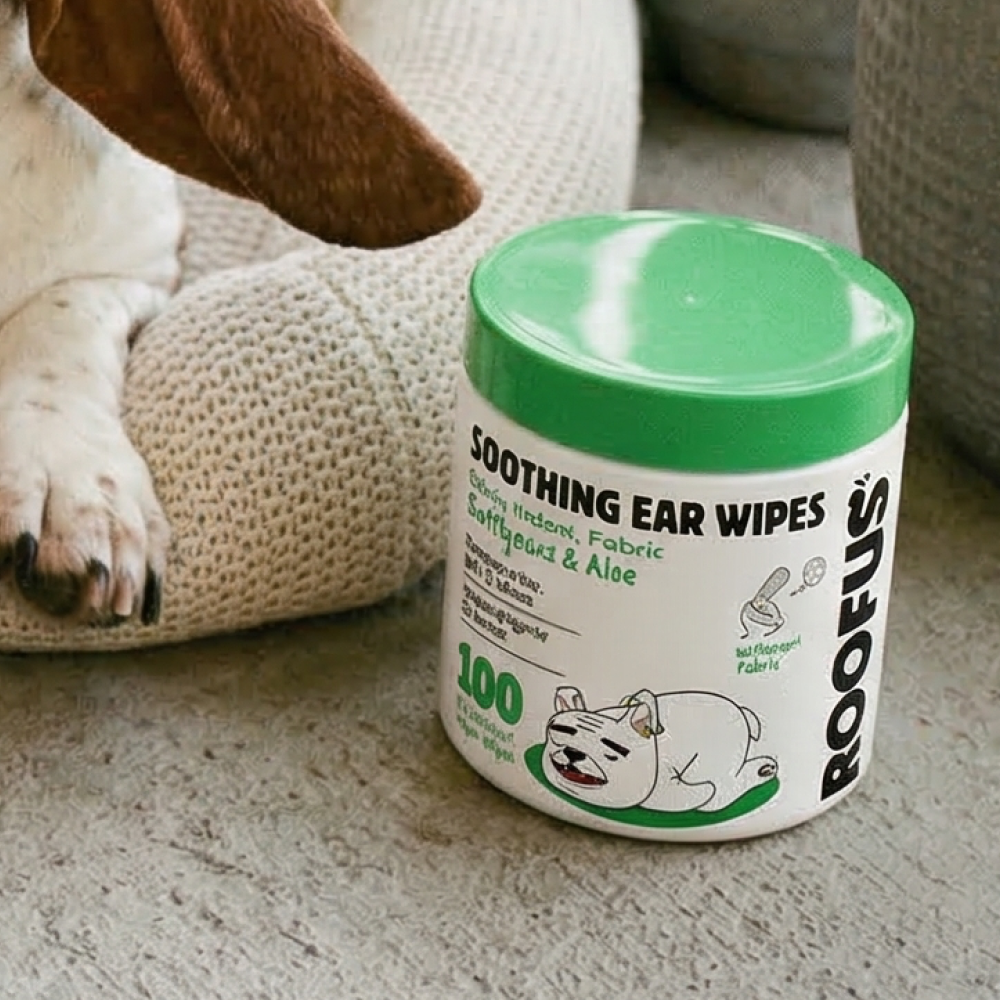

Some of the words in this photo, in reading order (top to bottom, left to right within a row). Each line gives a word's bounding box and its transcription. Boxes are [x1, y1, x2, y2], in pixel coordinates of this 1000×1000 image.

[470, 424, 620, 525] SOOTHING
[631, 495, 705, 536] EAR
[715, 491, 826, 537] WIPES
[562, 547, 579, 573] &
[585, 553, 638, 587] Aloe
[588, 529, 665, 560] Fabric
[820, 474, 890, 802] ROOFUS
[457, 642, 523, 725] 100
